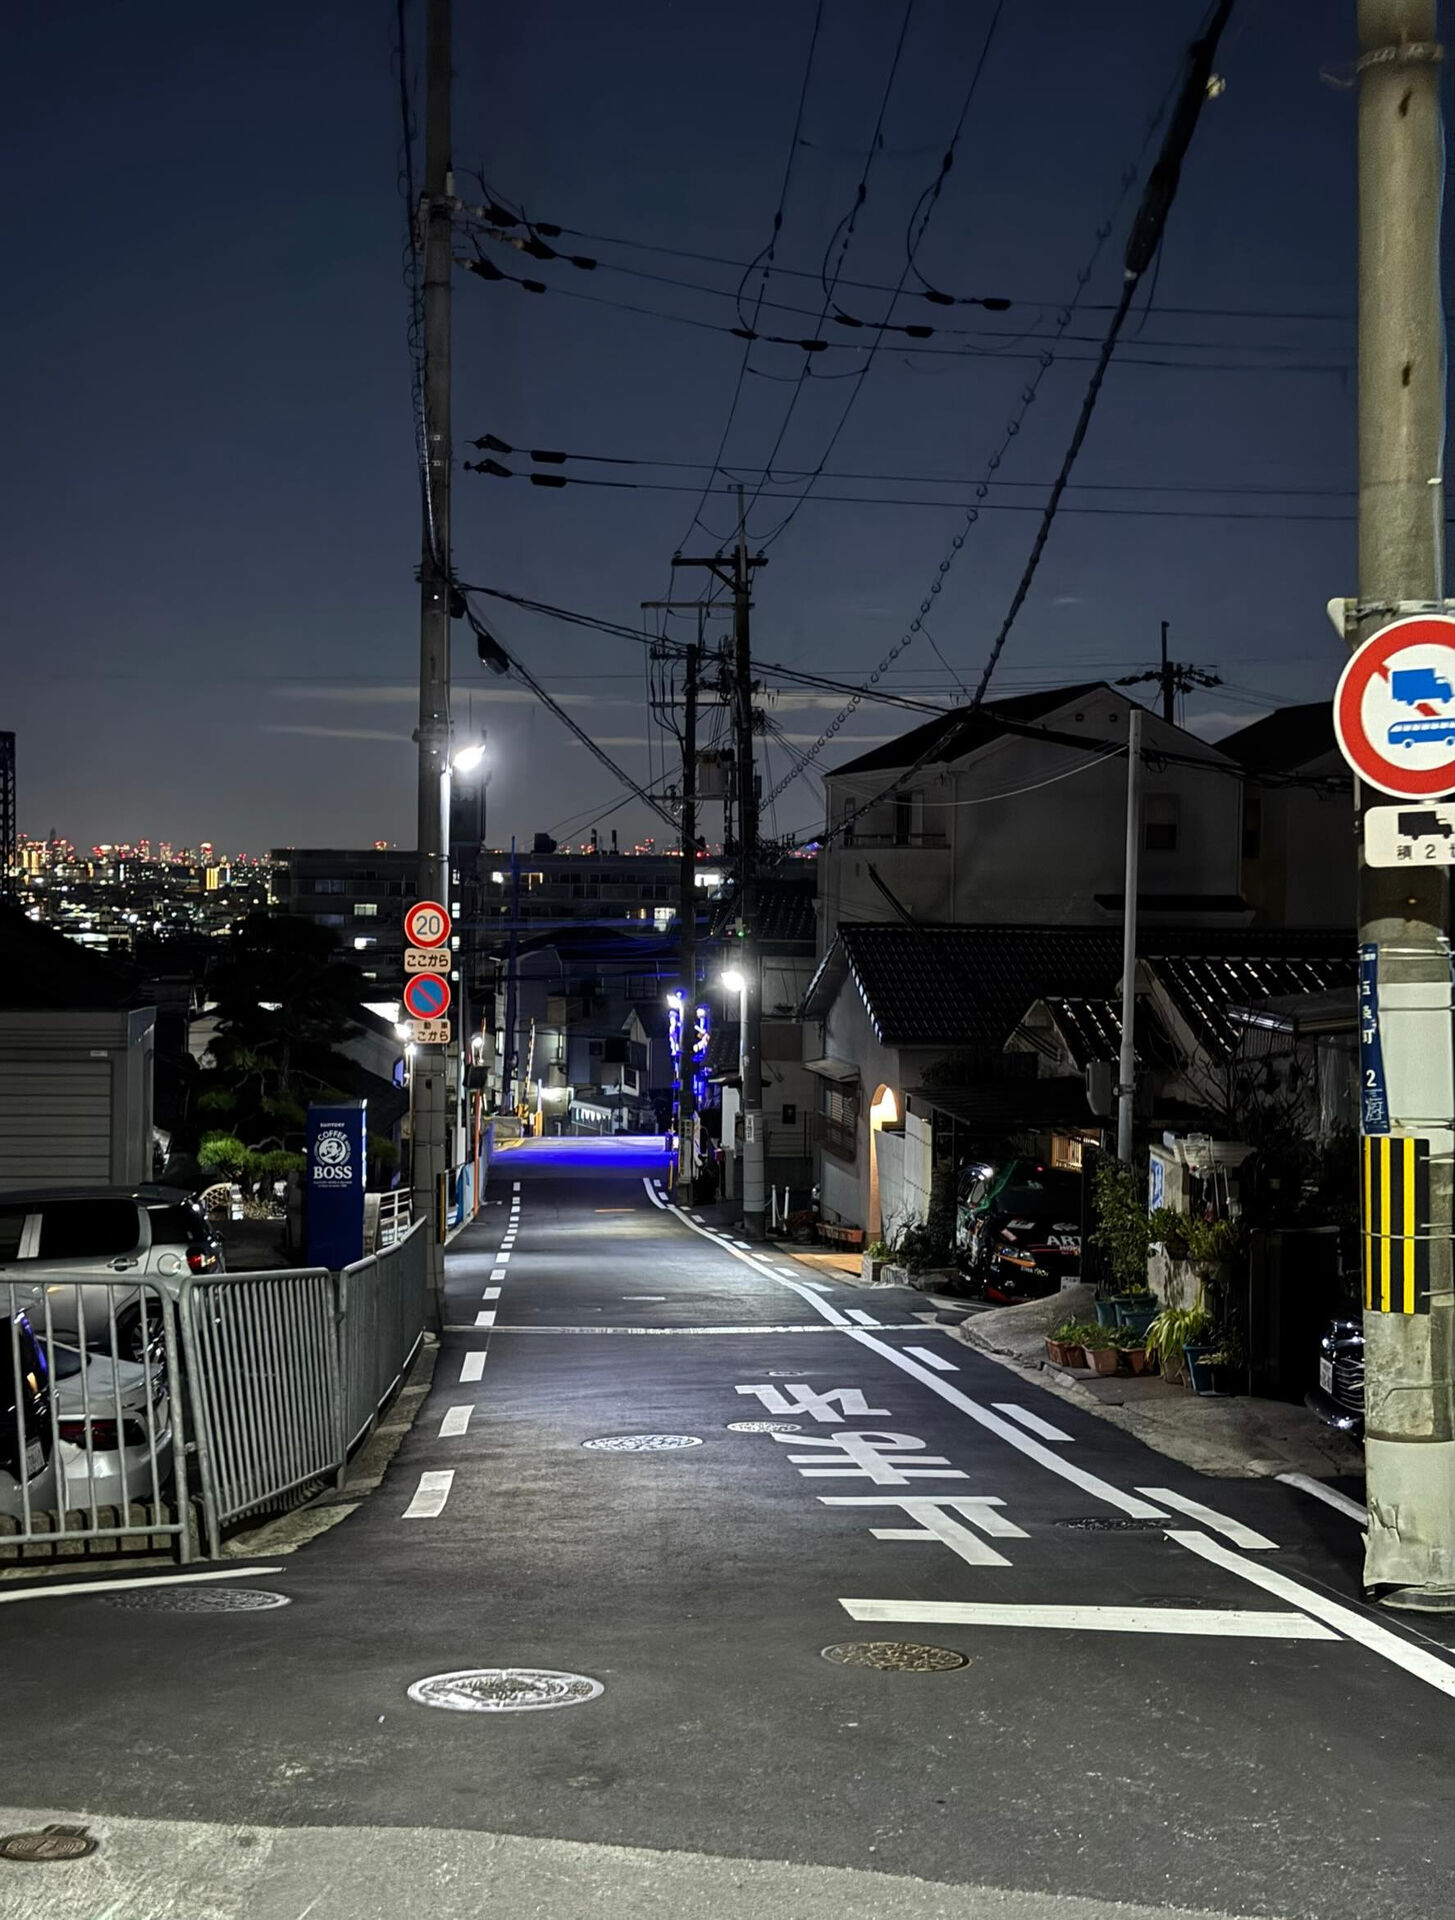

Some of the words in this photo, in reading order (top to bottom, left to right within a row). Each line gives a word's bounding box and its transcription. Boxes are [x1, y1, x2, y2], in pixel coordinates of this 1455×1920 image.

[416, 915, 440, 935] 20
[407, 954, 449, 967] ここから
[1365, 1069, 1377, 1087] 2
[318, 1129, 348, 1140] COFFEE
[313, 1166, 352, 1179] BOSS
[734, 1384, 1032, 1567] 止まれ
